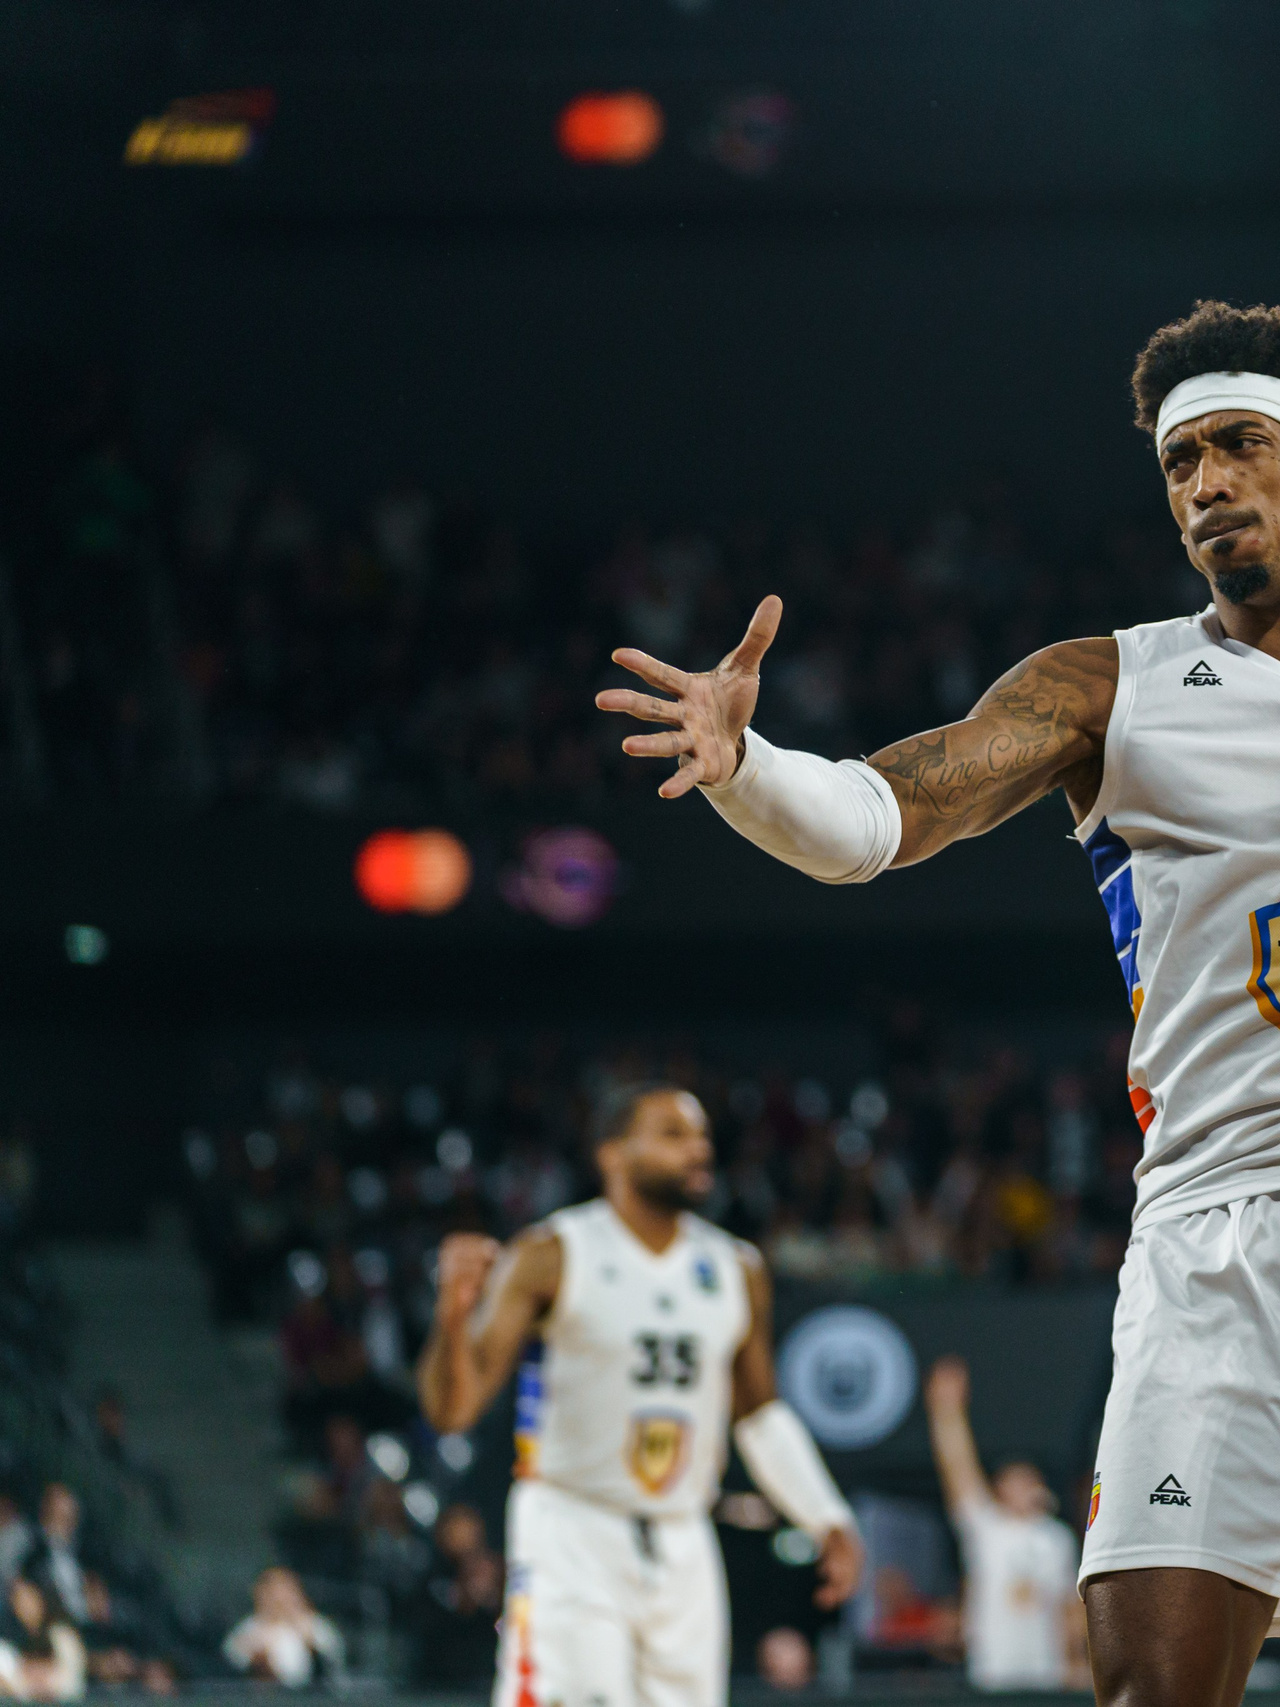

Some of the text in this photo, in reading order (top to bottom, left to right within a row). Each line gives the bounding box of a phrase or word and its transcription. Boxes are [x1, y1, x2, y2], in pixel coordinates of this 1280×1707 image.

[1183, 677, 1224, 687] PEAK
[912, 759, 978, 815] King
[630, 1333, 702, 1391] 35
[1149, 1493, 1192, 1507] PEAK
